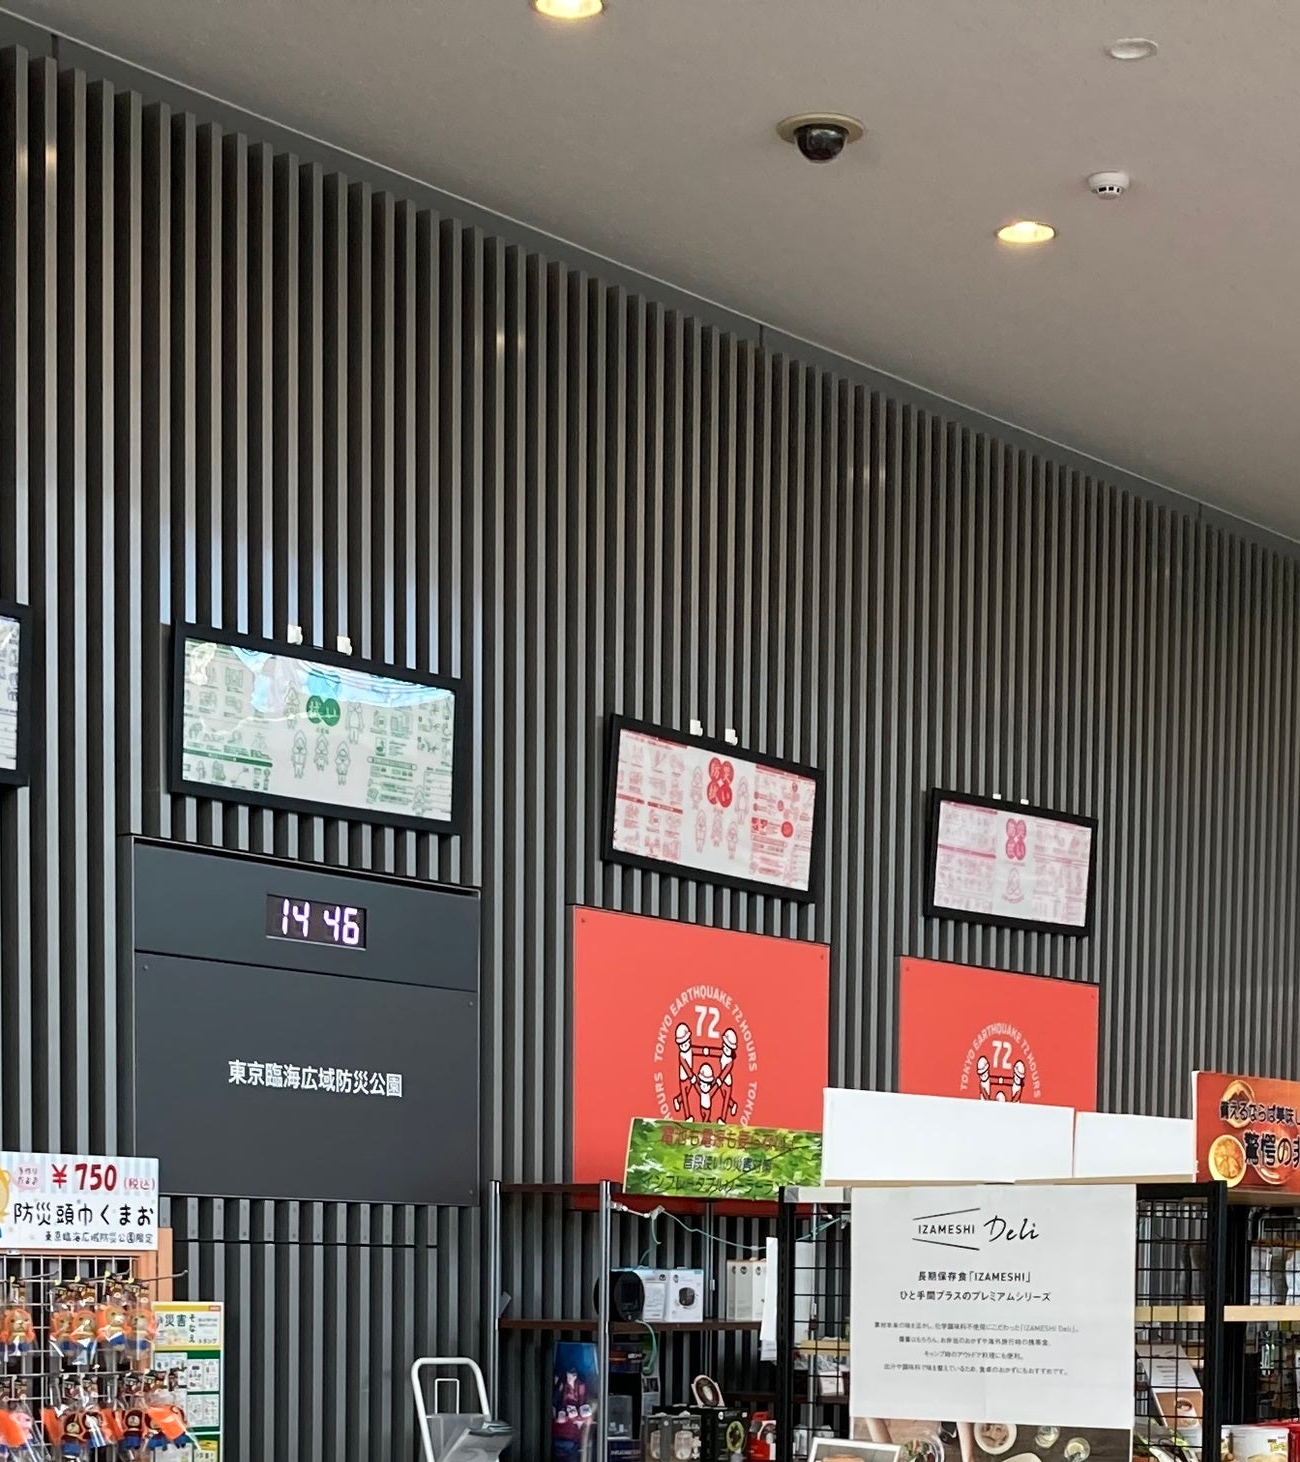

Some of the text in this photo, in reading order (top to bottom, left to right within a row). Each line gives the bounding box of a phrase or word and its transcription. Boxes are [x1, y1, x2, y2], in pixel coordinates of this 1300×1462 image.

[281, 898, 362, 946] 14 46
[669, 985, 733, 1017] EARTHQUAKE
[694, 1004, 721, 1039] 72
[991, 1039, 1013, 1070] 72
[227, 1059, 403, 1098] 東京臨海広域防災公園
[13, 1200, 155, 1227] 防災頭巾くまお
[917, 1214, 1040, 1243] IZAMESHI Deli
[917, 1271, 1032, 1284] 長期保存食「IZAMESHI」
[899, 1290, 1052, 1302] ひと手間プラスのプレミアムシリーズ
